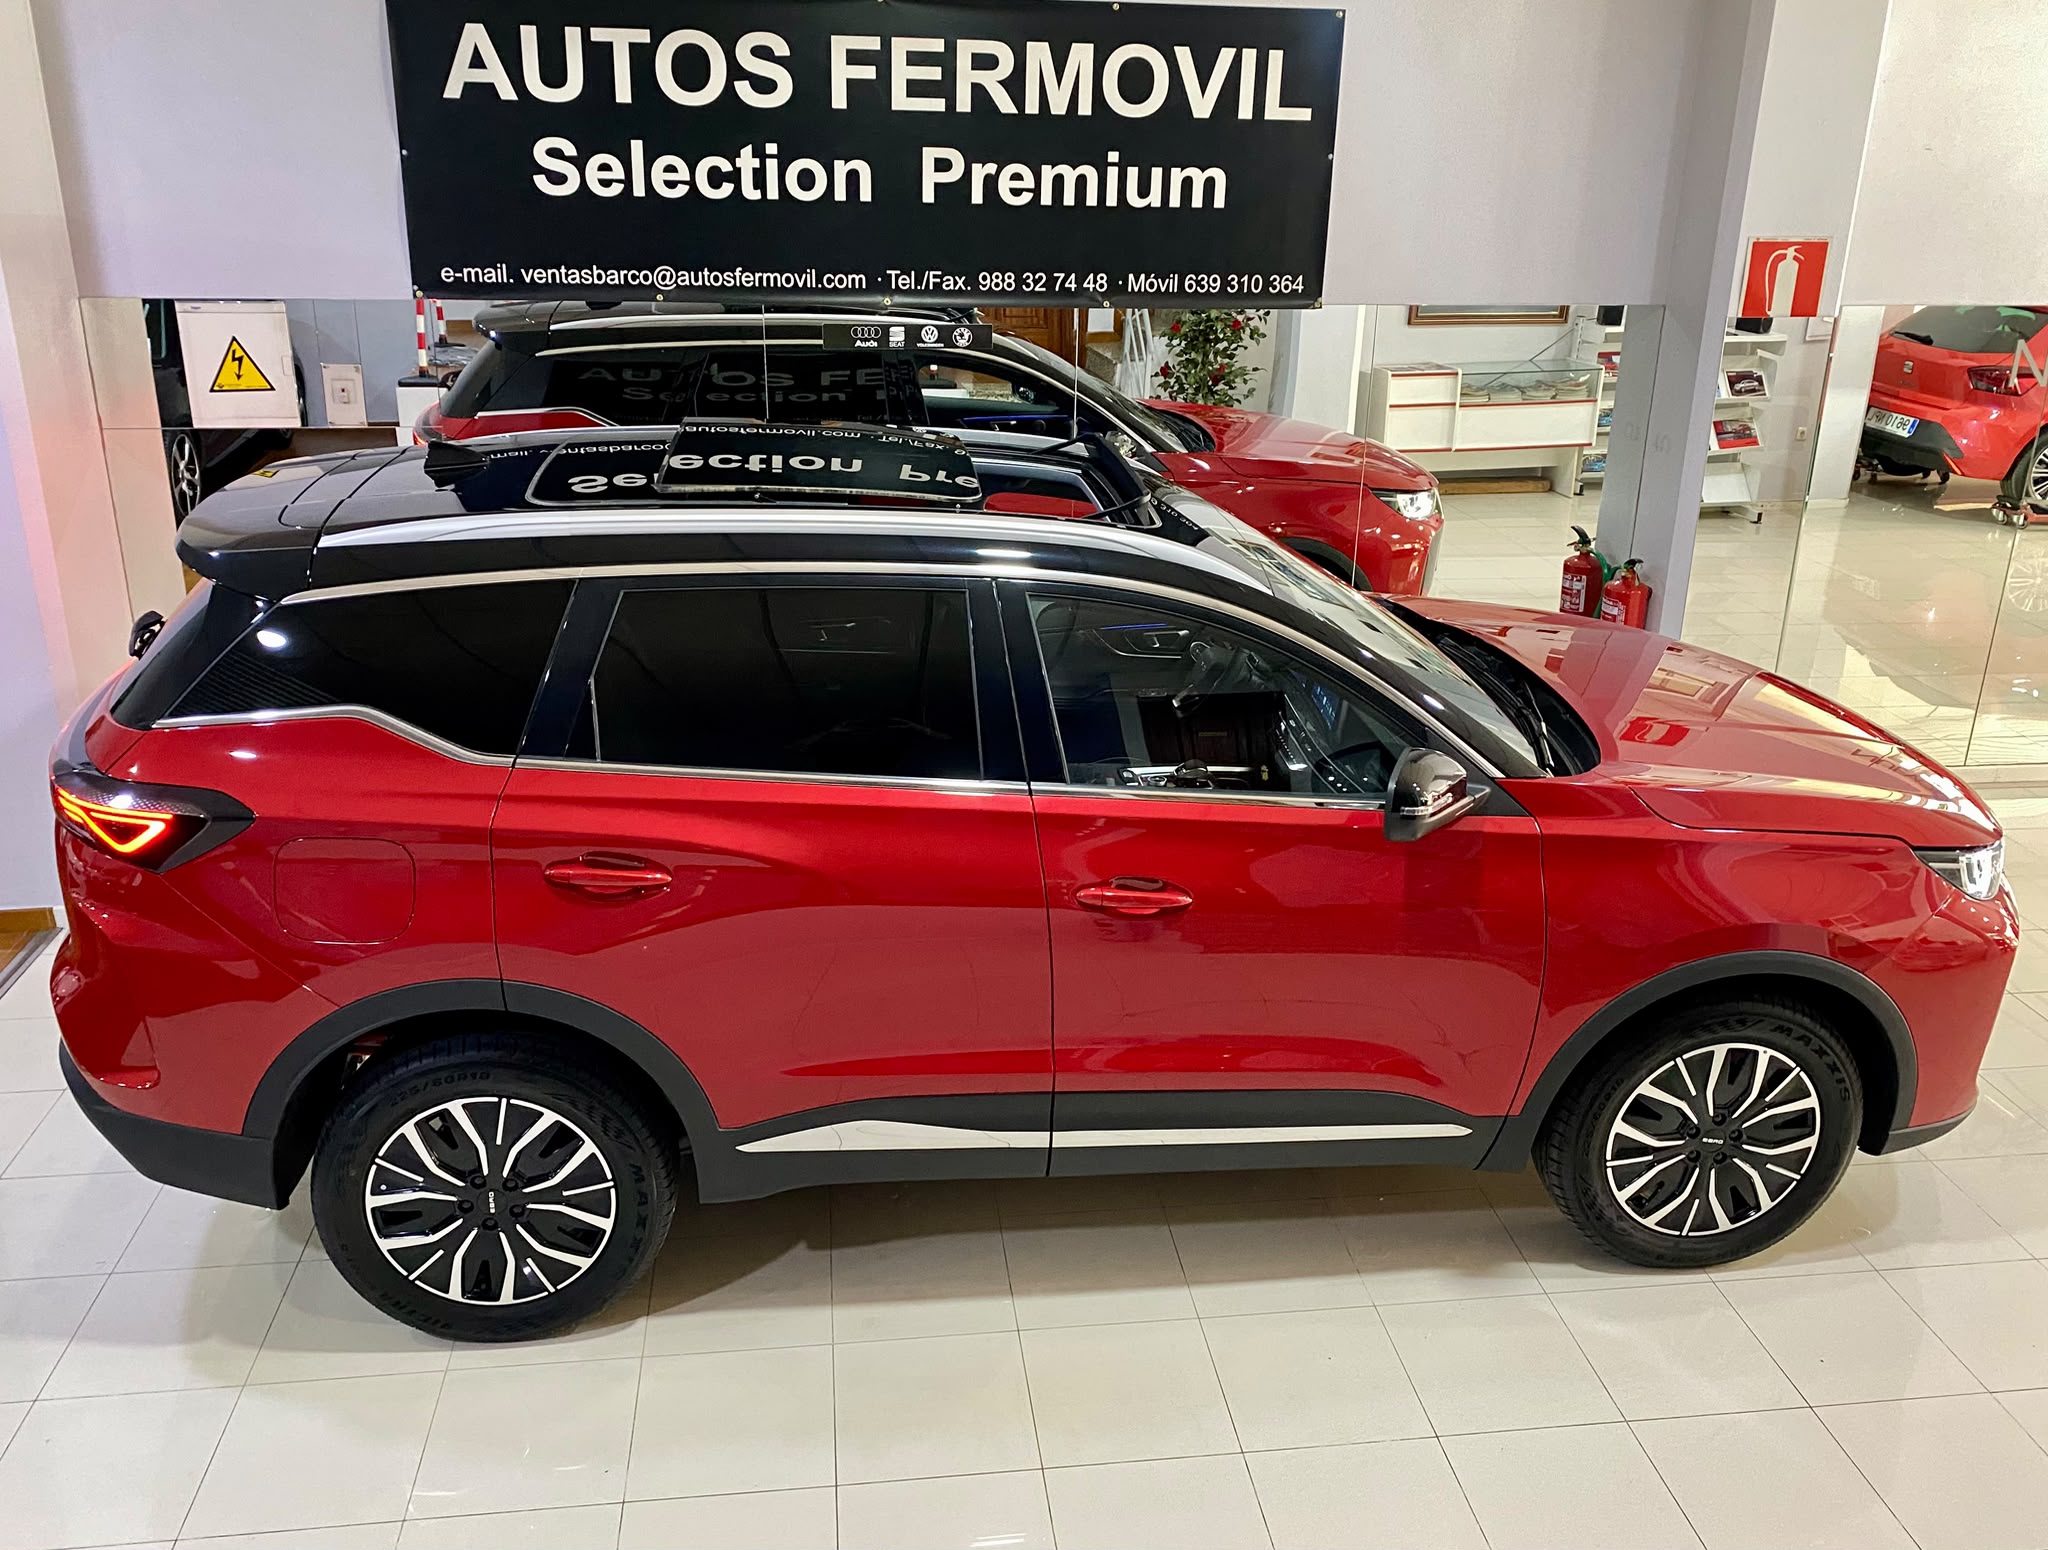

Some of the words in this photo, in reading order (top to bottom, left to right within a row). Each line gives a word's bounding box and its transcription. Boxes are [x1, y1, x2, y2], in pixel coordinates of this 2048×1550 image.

[442, 22, 793, 109] AUTOS
[830, 34, 1313, 121] FERMOVIL
[532, 136, 872, 202] Selection
[922, 146, 1227, 209] Premium
[440, 263, 514, 284] e-mail.
[520, 264, 867, 291] ventasbarco@autosfermovil.com
[886, 269, 970, 291] Tel./Fax.
[978, 271, 1016, 292] 988
[1022, 272, 1047, 292] 32
[1053, 272, 1078, 292] 74
[1082, 272, 1108, 292] 48
[1127, 273, 1179, 293] Móvil
[1184, 273, 1221, 293] 639
[1226, 274, 1263, 294] 310
[1268, 274, 1304, 294] 364
